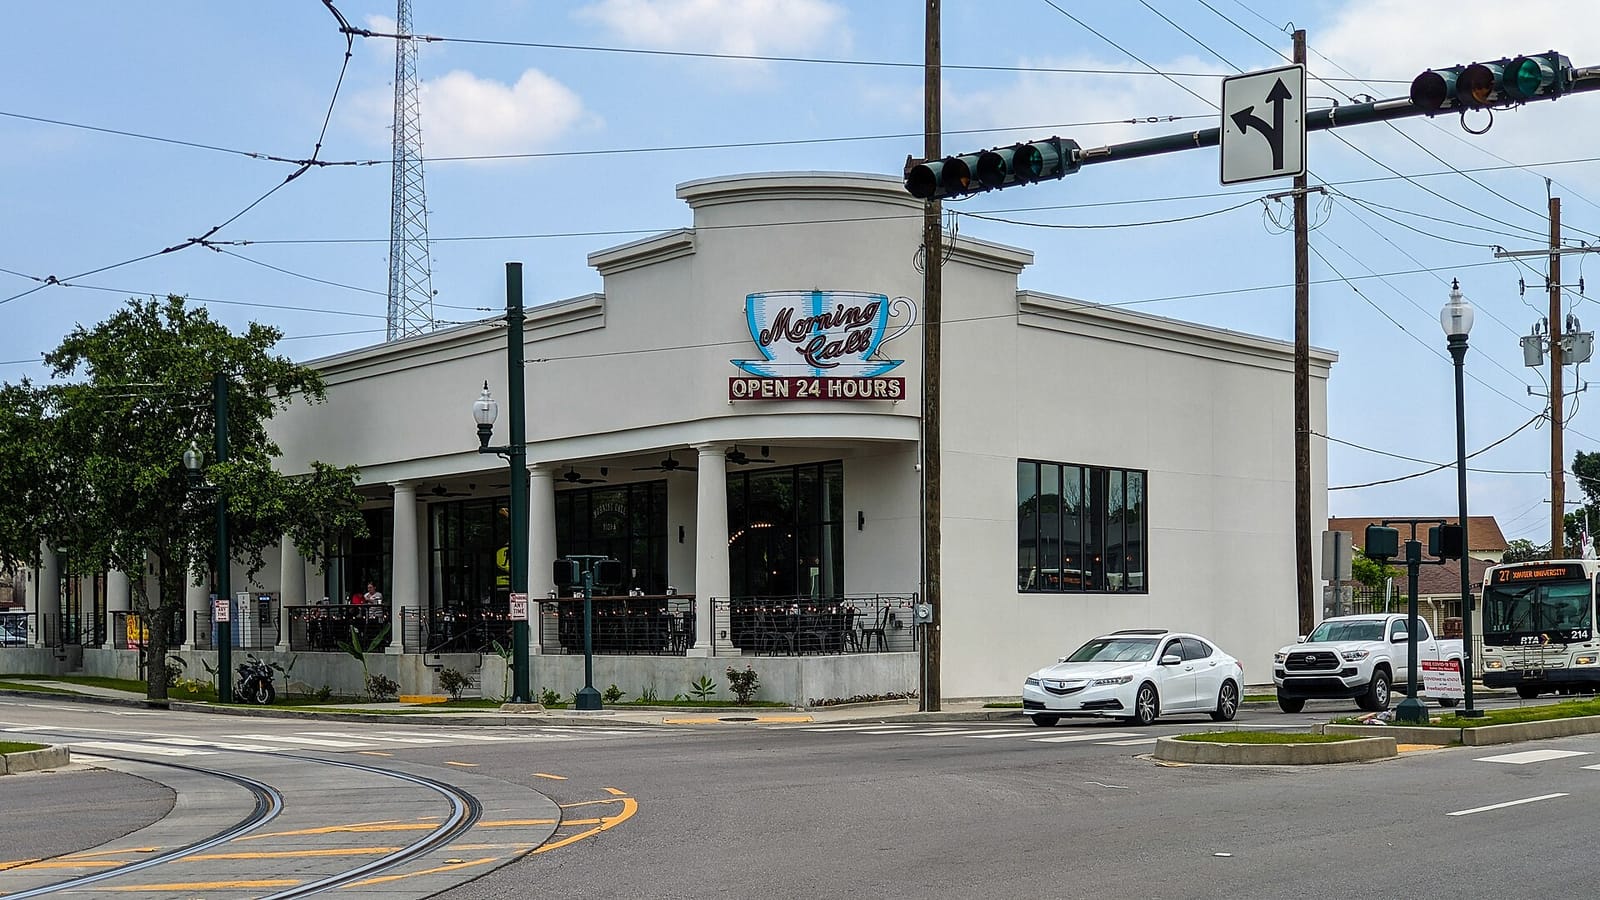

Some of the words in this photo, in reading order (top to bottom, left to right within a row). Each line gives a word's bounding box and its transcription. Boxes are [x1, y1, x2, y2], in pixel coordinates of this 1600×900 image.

[760, 301, 882, 347] Morning
[796, 327, 873, 369] Call
[732, 379, 789, 398] OPEN
[796, 379, 821, 398] 24
[828, 379, 901, 398] HOURS
[1499, 570, 1510, 582] 27
[1512, 571, 1533, 579] XAVIER
[1534, 568, 1566, 577] UNIVERSITY
[1520, 636, 1540, 645] RTA
[1571, 630, 1589, 639] 214
